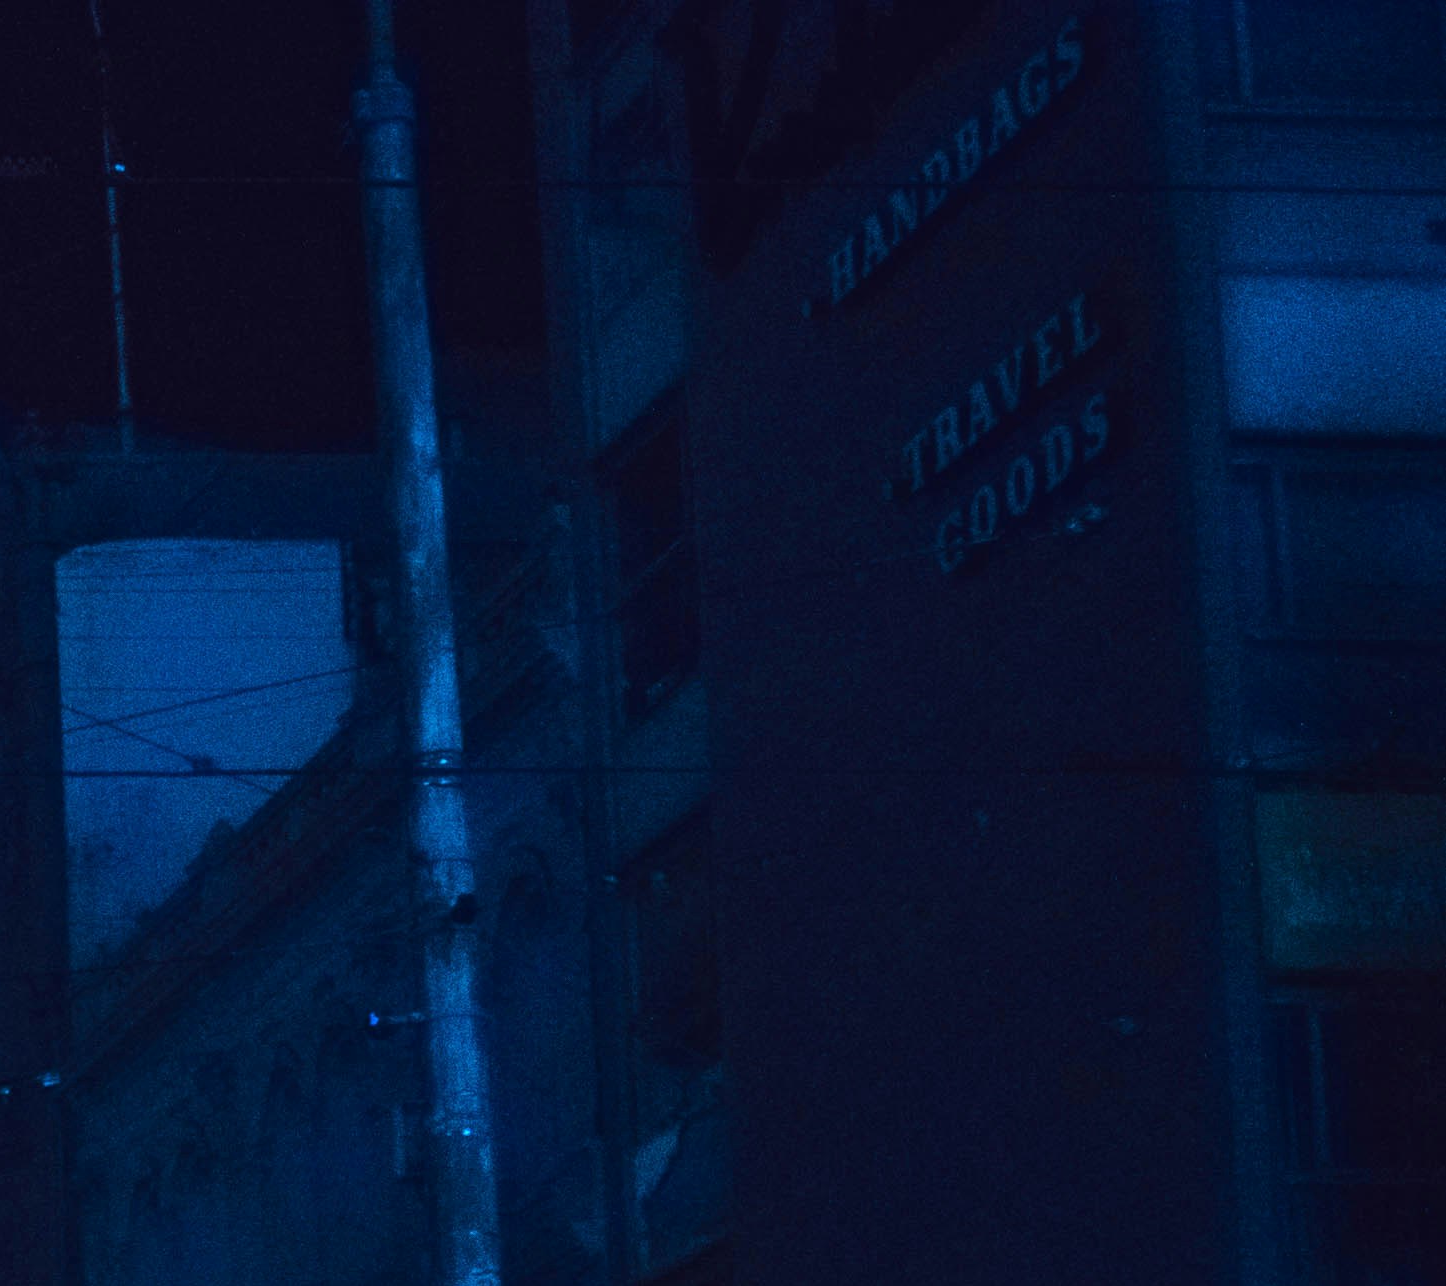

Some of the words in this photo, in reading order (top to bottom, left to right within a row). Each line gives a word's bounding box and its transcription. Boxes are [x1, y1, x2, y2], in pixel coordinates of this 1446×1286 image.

[826, 17, 1082, 303] HANDBAGS
[902, 289, 1101, 494] TRAVEL
[936, 392, 1110, 575] GOODS
